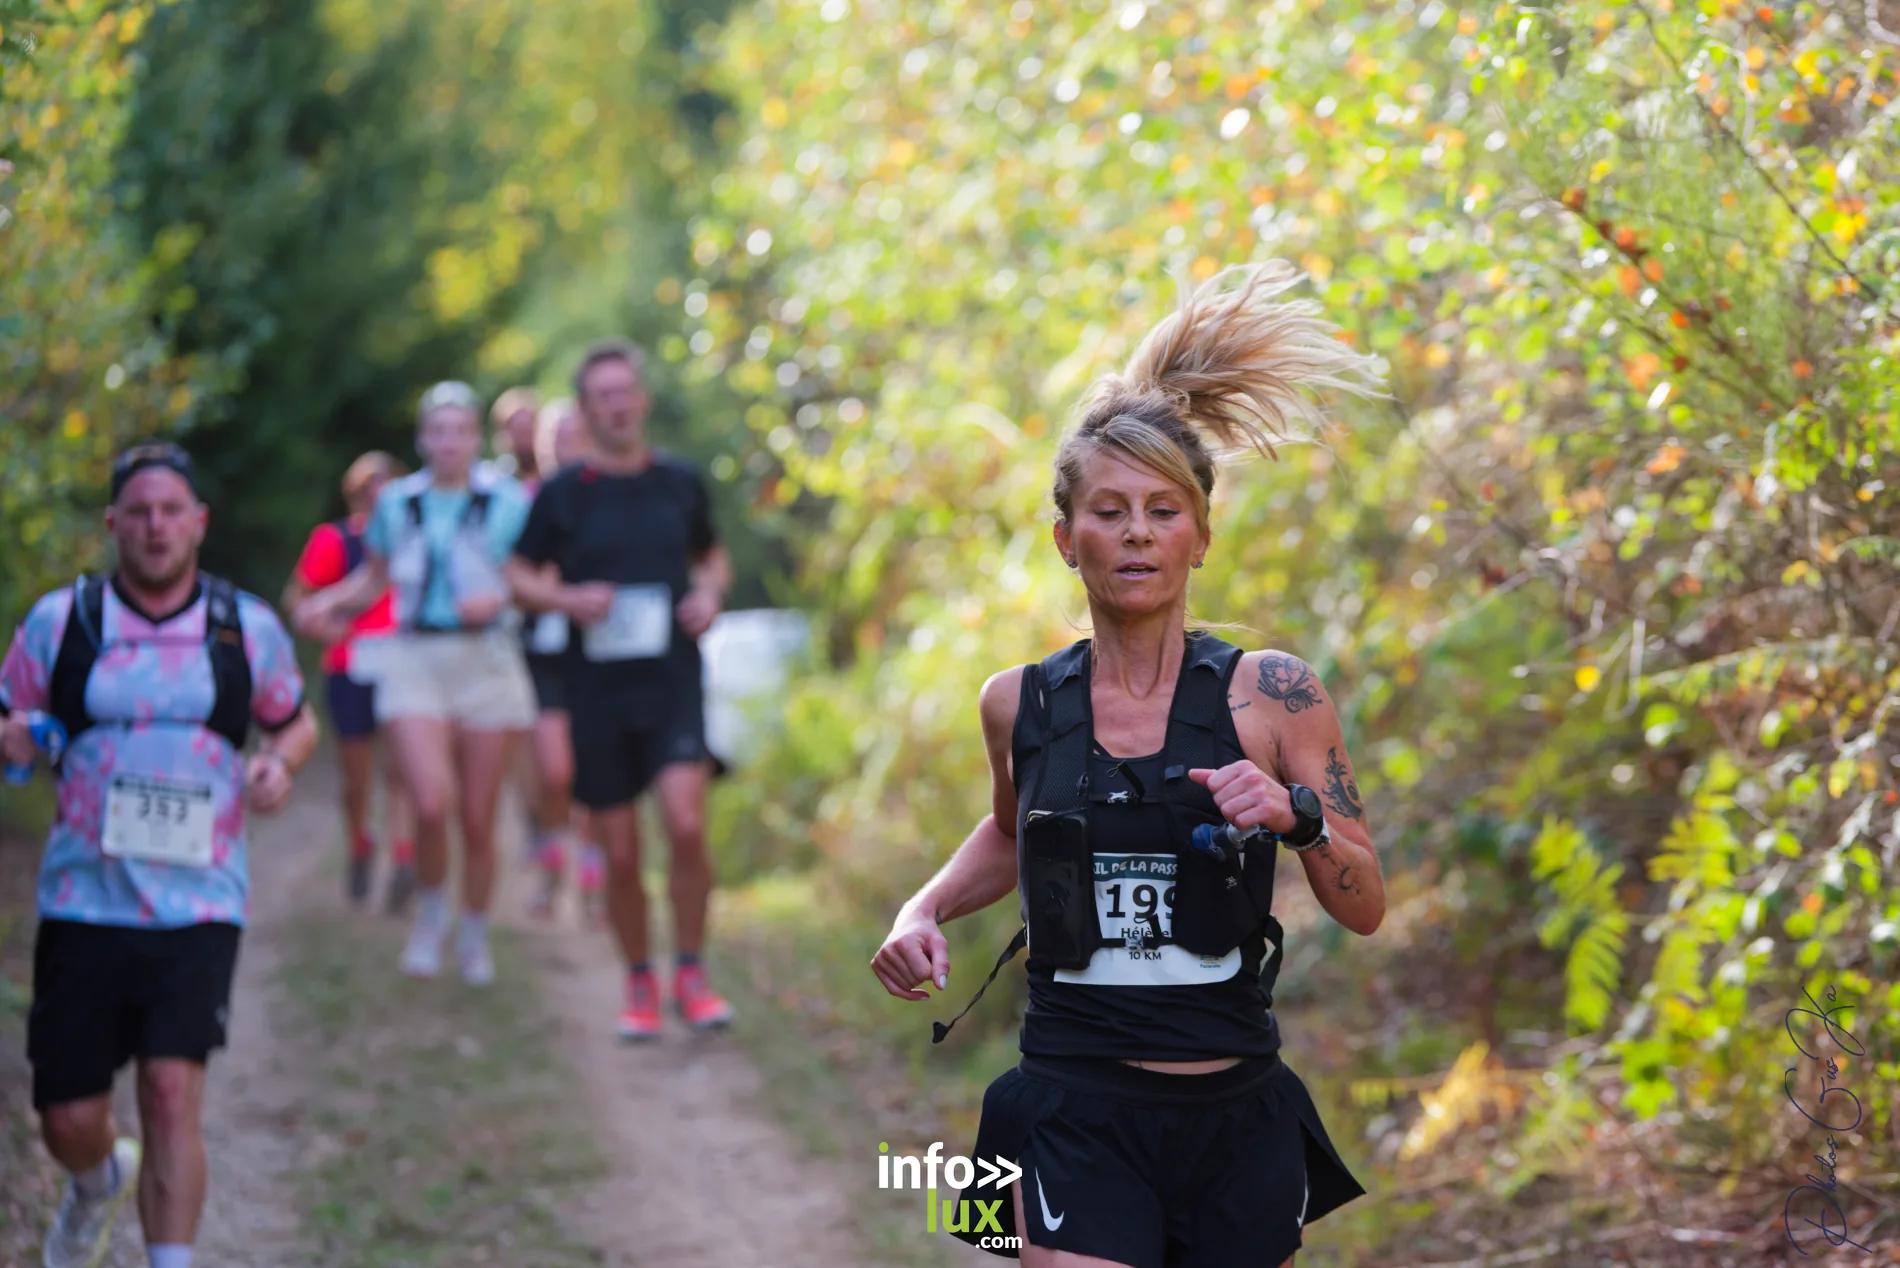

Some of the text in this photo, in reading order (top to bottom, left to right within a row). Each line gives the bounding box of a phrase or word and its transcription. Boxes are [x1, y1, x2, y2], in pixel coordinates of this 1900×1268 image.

[1093, 862, 1109, 875] IL
[1111, 861, 1128, 874] DE
[1130, 860, 1147, 872] LA
[1121, 926, 1169, 938] Hélèe
[1128, 951, 1162, 960] 10 KM
